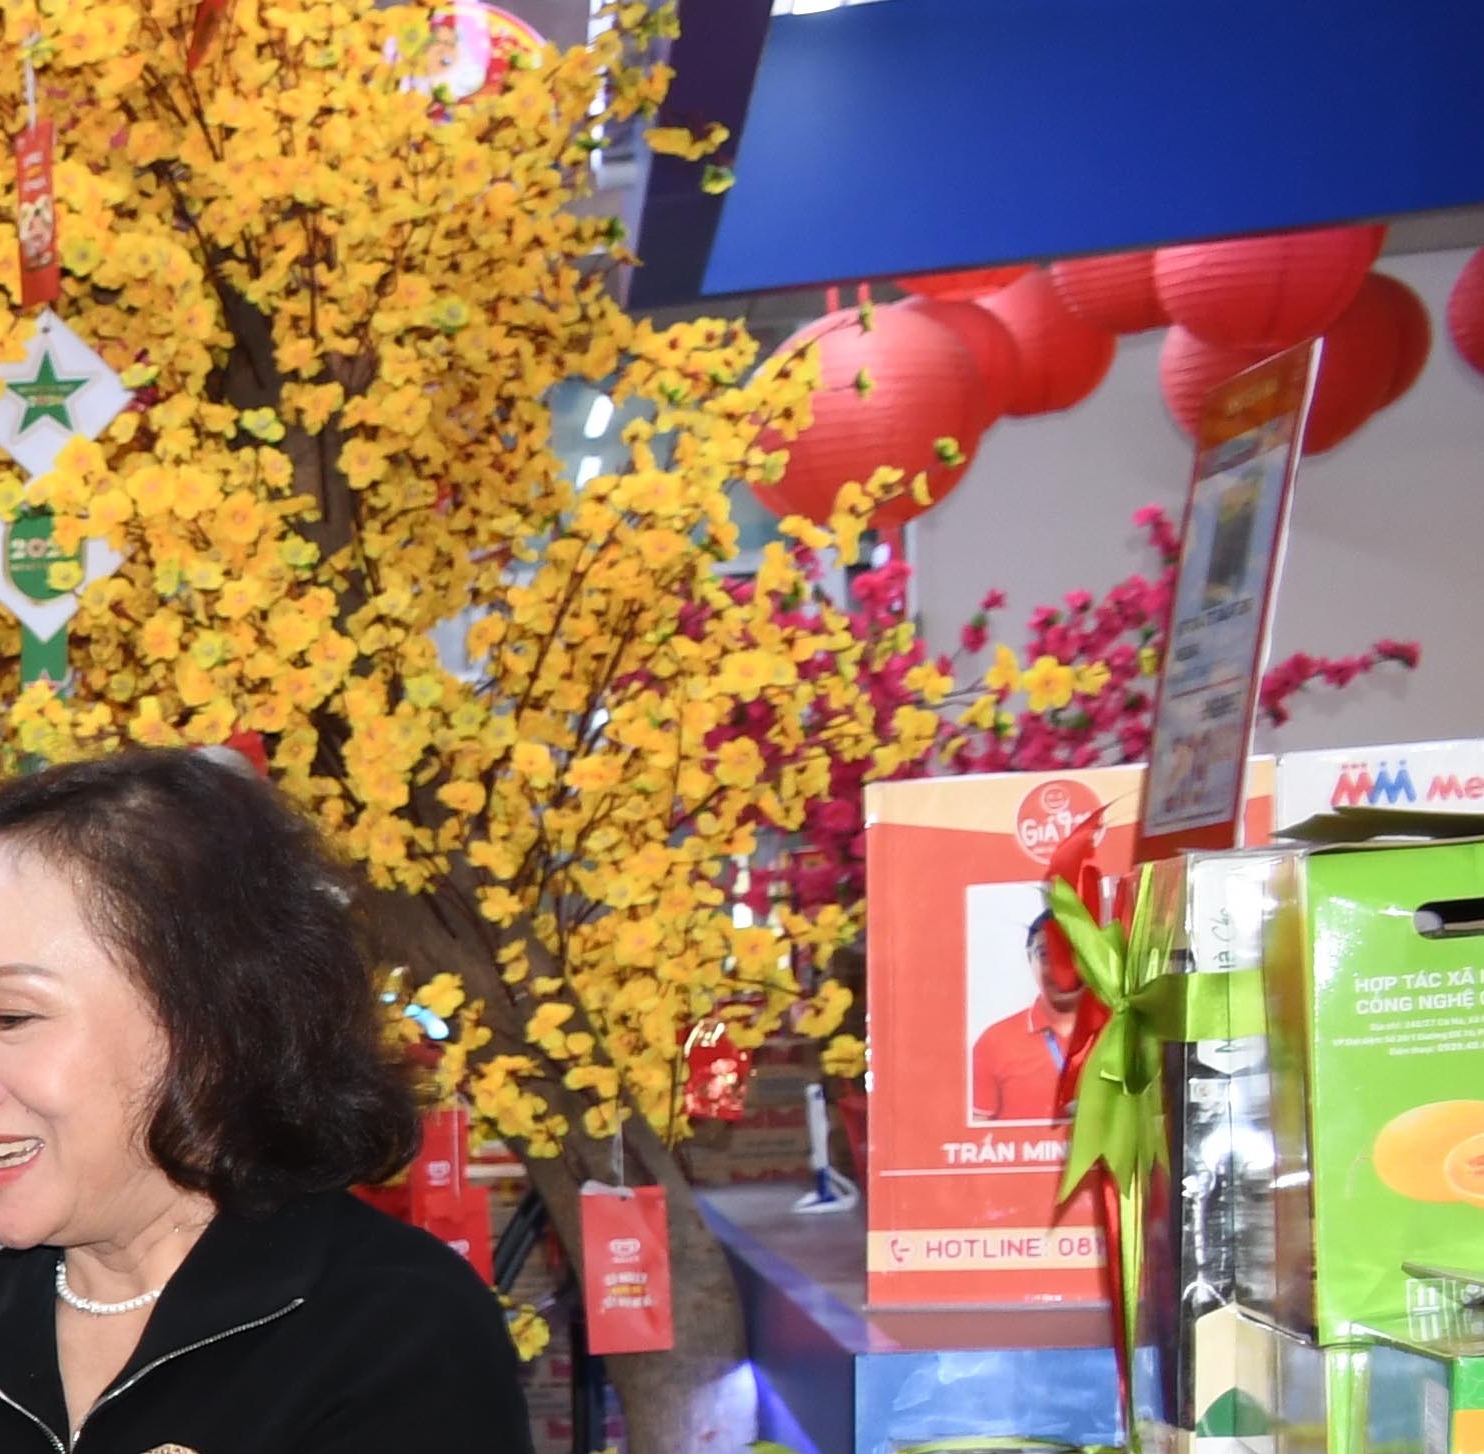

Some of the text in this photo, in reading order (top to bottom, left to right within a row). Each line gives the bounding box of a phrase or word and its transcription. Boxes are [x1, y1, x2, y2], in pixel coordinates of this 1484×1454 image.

[1354, 966, 1476, 997] HỢP TÁC XÃ
[1419, 988, 1475, 1011] NGHỆ
